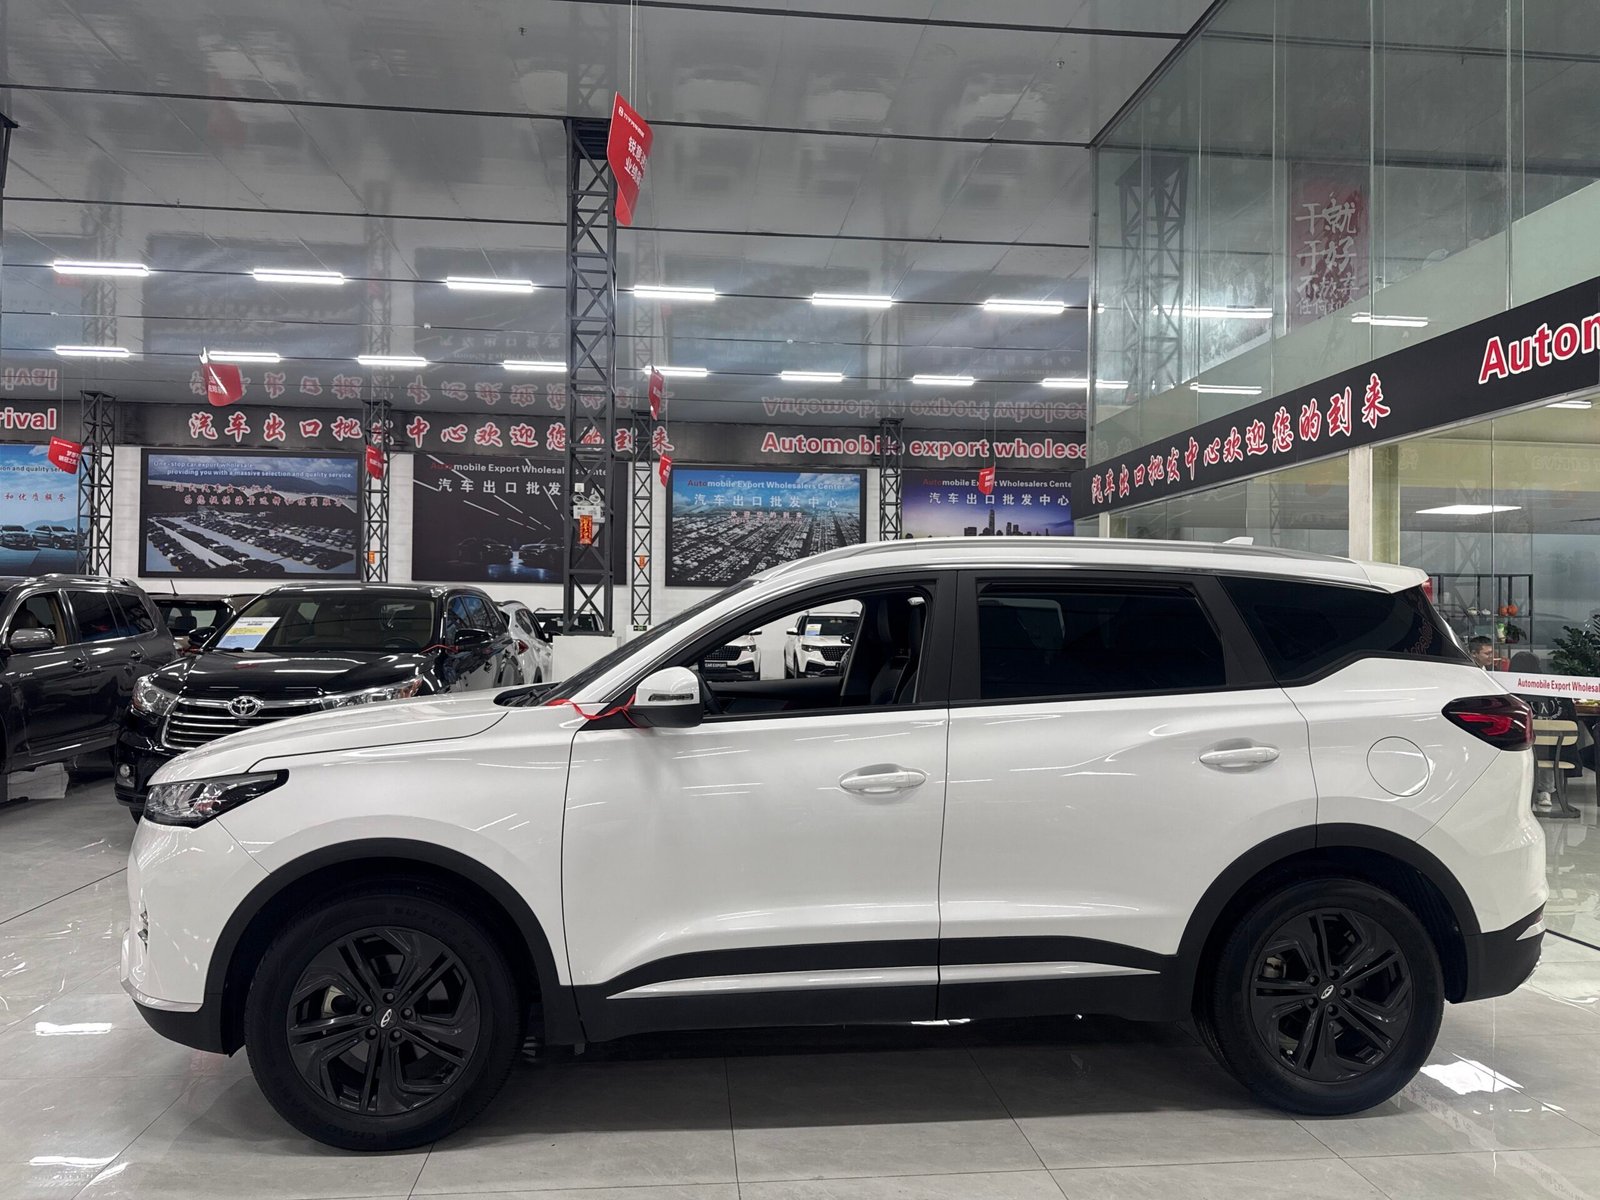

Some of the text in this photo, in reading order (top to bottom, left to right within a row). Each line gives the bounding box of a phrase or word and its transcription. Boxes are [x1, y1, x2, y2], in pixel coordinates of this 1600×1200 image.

[0, 407, 57, 430] ival
[1091, 372, 1391, 504] 汽车出口批发中心欢迎您的到来
[910, 438, 990, 460] export
[26, 465, 49, 473] quality
[167, 469, 199, 477] providing
[430, 462, 486, 472] Automobile
[488, 463, 520, 475] Export
[522, 464, 579, 475] Wholesals
[687, 479, 735, 488] Automobile
[737, 480, 764, 490] Export
[766, 481, 816, 490] Wholesalers
[923, 478, 970, 487] Automobile
[971, 479, 997, 488] Ext
[999, 480, 1048, 488] Wholesalers
[694, 493, 838, 509] 汽车出口批发中心
[929, 492, 1069, 506] 汽车出口批发中心
[1517, 677, 1550, 689] Automobile
[1551, 680, 1571, 692] Export
